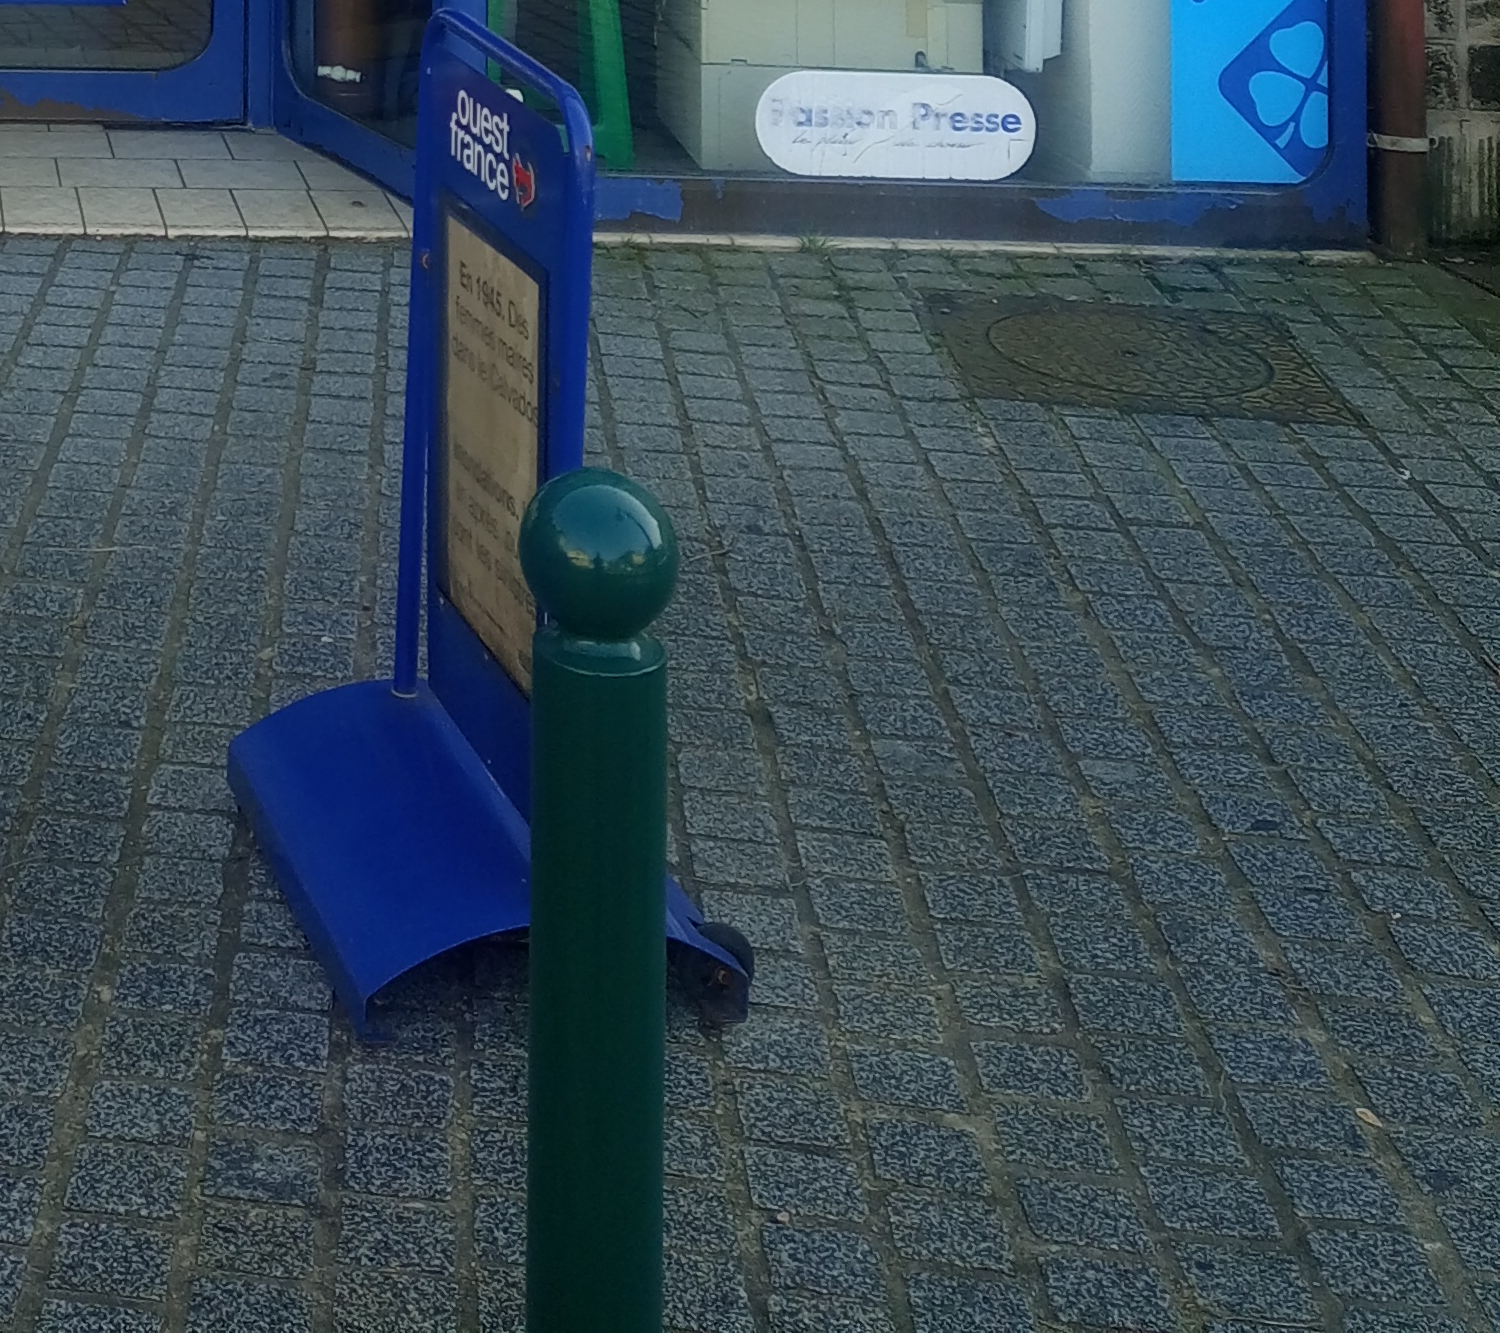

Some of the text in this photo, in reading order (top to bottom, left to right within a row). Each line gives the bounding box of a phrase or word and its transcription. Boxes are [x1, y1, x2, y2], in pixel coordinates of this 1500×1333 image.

[450, 111, 510, 201] france
[457, 89, 510, 161] ouest
[911, 101, 1023, 134] Presse
[455, 294, 534, 385] femmes maires
[459, 260, 530, 341] En 1945. Des
